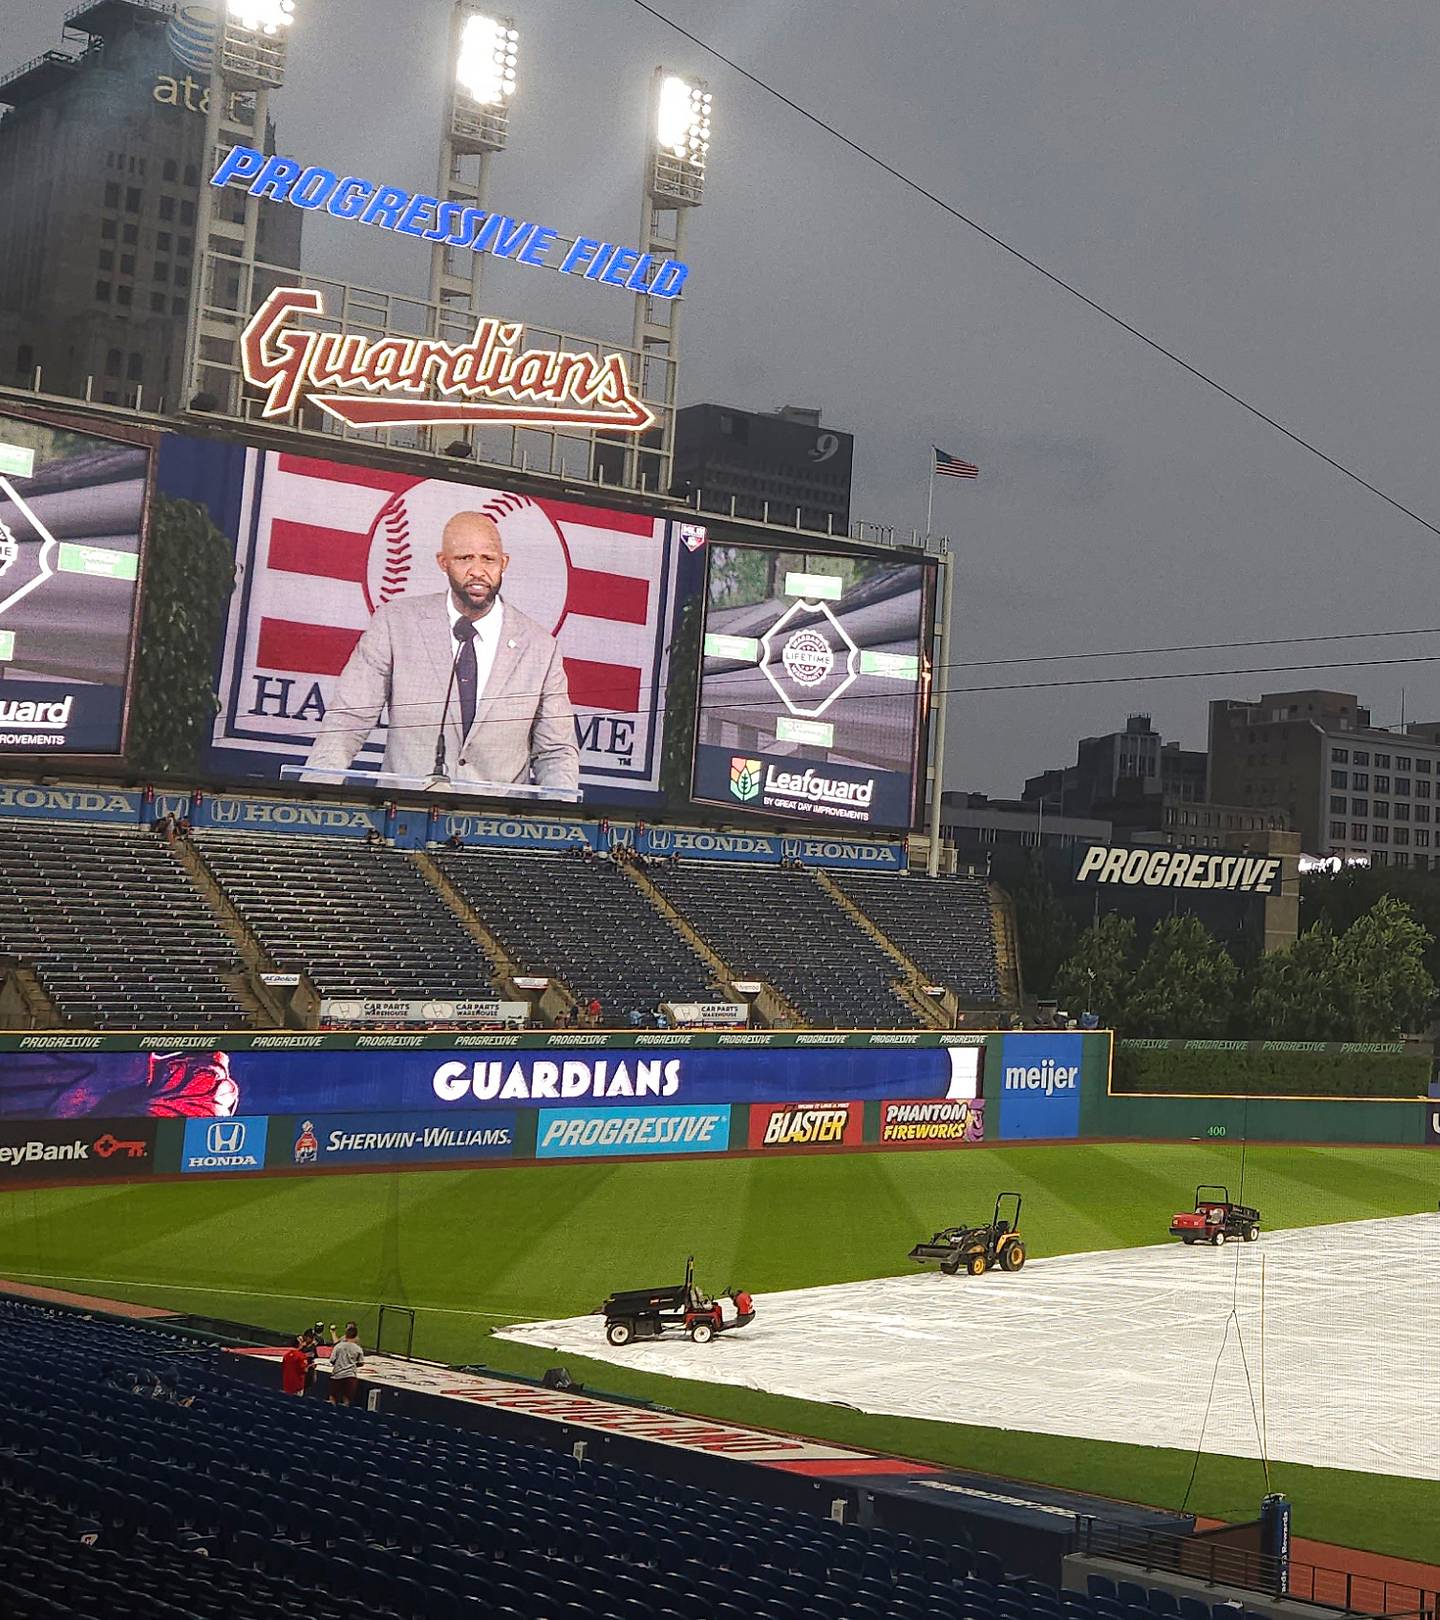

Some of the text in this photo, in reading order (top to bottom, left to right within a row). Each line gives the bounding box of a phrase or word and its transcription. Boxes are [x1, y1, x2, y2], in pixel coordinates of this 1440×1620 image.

[210, 144, 690, 300] PROGRESSIVE FIELD
[241, 287, 655, 430] Guardians
[806, 433, 839, 463] 9
[785, 653, 830, 665] LIFETIME
[765, 764, 874, 802] Leafguard
[244, 804, 375, 829] HONDA
[764, 797, 869, 821] BY GREAT DAY IMPROVEMENTS
[475, 820, 589, 843] HONDA
[674, 834, 774, 854] HONDA
[803, 843, 897, 862] HONDA
[1076, 847, 1280, 893] PROGRESSIVE
[20, 1037, 102, 1048] PROGRESSIVE
[140, 1037, 216, 1048] PROGRESSIVE
[251, 1036, 325, 1047] PROGRESSIVE
[356, 1036, 424, 1046] PROGRESSIVE
[454, 1036, 520, 1046] PROGRESSIVE
[547, 1035, 608, 1045] PROGRESSIVE
[635, 1035, 694, 1045] PROGRESSIVE
[718, 1035, 773, 1045] PROGRESSIVE
[796, 1034, 849, 1044] PROGRESSIVE
[869, 1034, 920, 1044] PROGRESSIVE
[939, 1034, 986, 1044] PROGRESSIVE
[1184, 1040, 1248, 1050] PROGRESSIVE
[1262, 1041, 1327, 1052] PROGRESSIVE
[1340, 1042, 1404, 1053] PROGRESSIVE
[433, 1059, 681, 1101] GUARDIANS
[1005, 1059, 1078, 1096] meijer
[886, 1103, 967, 1122] PHANTOM
[541, 1116, 720, 1147] PROGRESSIVE
[763, 1111, 847, 1144] BLASTER
[883, 1122, 966, 1140] FIREWORKS
[1207, 1126, 1226, 1136] 400
[0, 1140, 88, 1166] eyBank
[188, 1155, 258, 1168] HONDA
